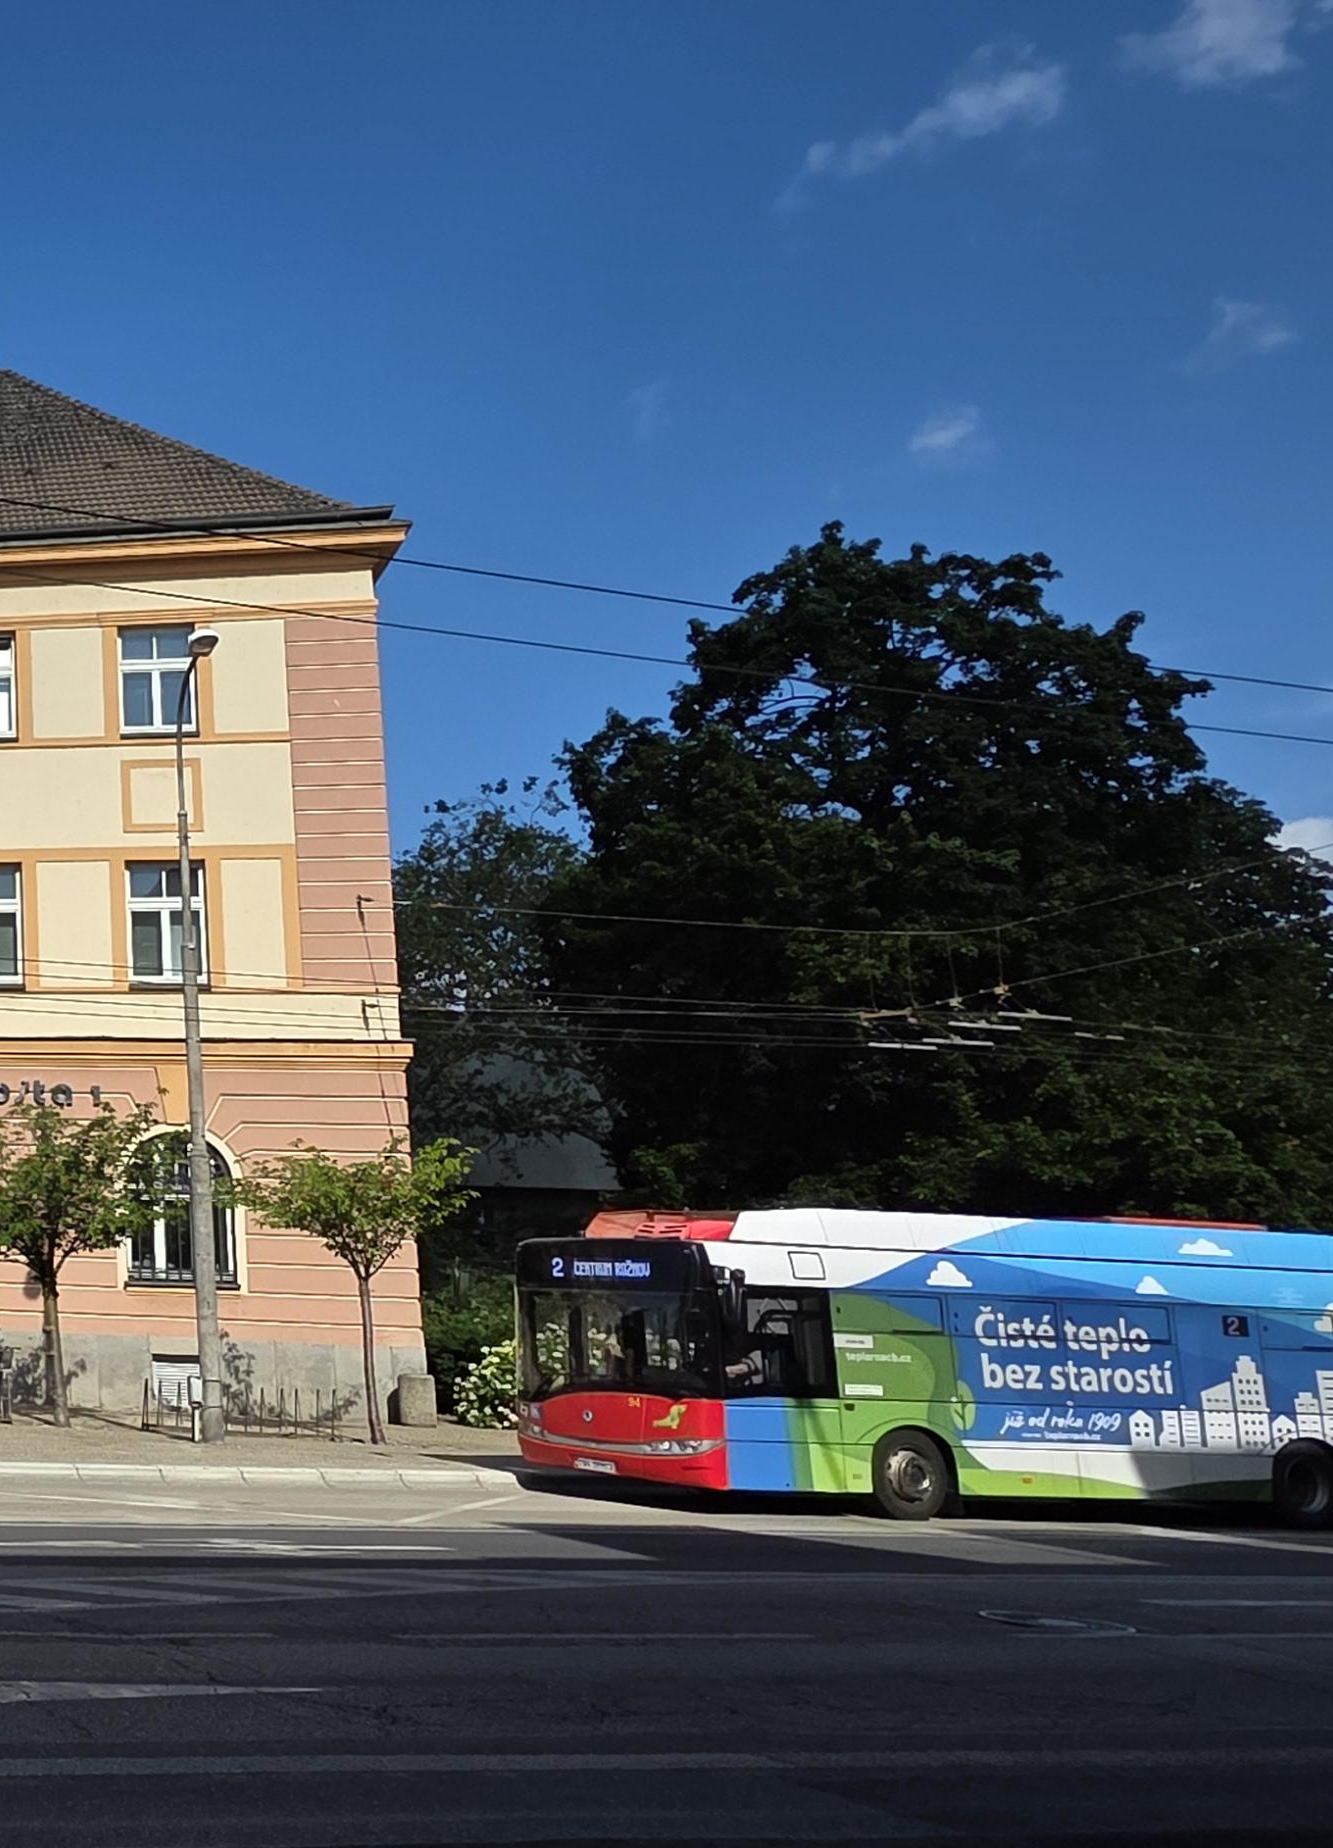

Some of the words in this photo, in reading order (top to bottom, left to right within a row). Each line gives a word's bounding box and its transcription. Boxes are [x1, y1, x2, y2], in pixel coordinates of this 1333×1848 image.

[90, 1085, 101, 1107] 1
[552, 1257, 564, 1277] 2
[974, 1306, 1057, 1348] Čisté
[1064, 1317, 1151, 1360] teplo
[1227, 1316, 1240, 1336] 2
[980, 1353, 1043, 1389] bez
[1050, 1360, 1173, 1394] starostí
[1029, 1407, 1051, 1428] od
[1088, 1412, 1121, 1431] 1909
